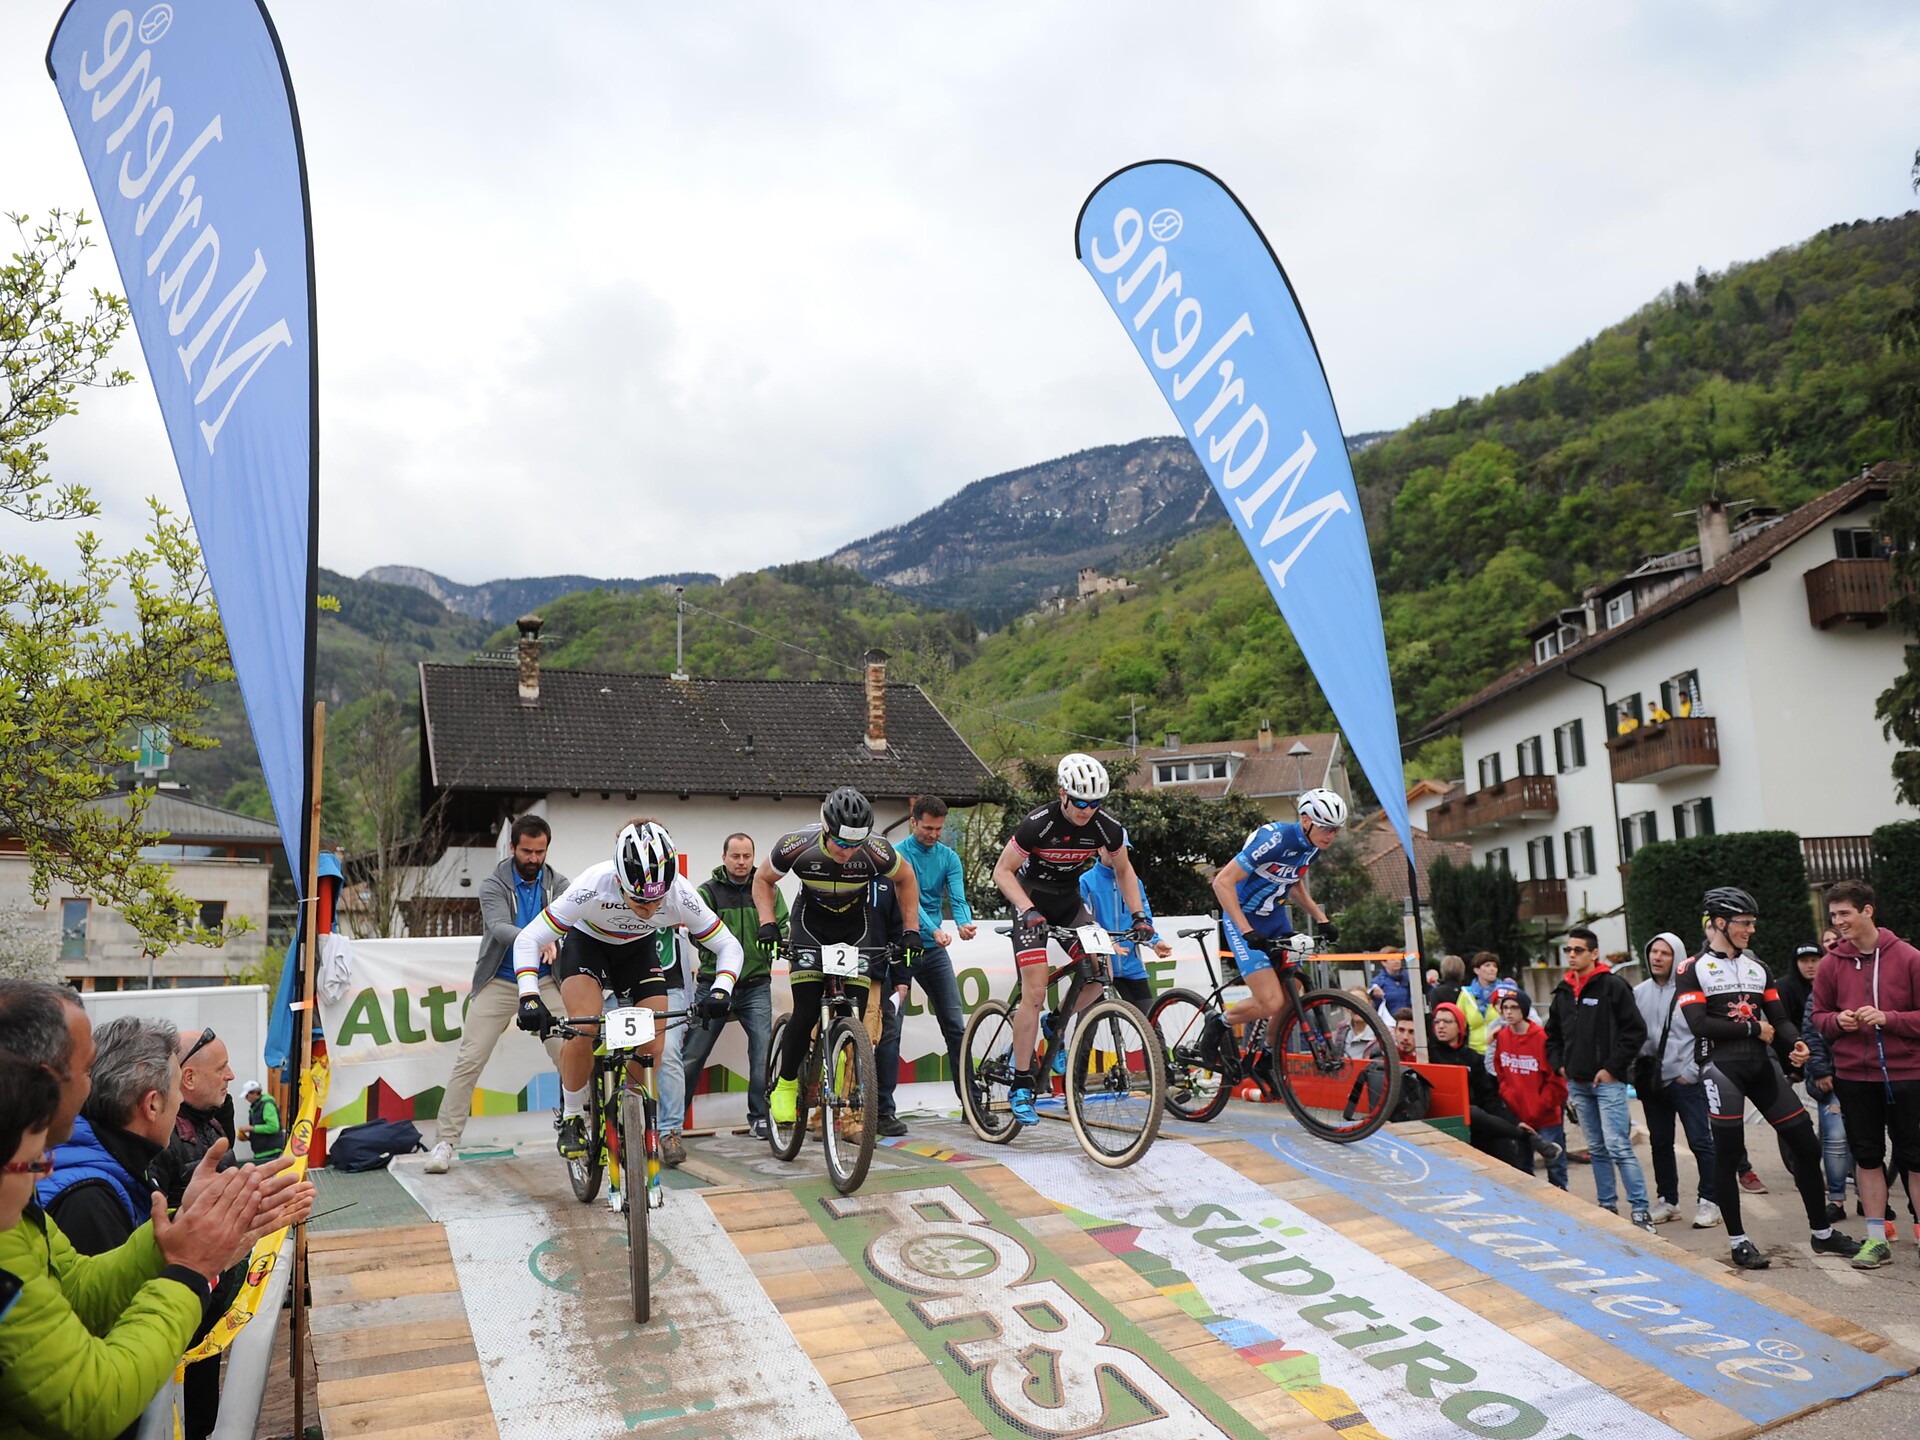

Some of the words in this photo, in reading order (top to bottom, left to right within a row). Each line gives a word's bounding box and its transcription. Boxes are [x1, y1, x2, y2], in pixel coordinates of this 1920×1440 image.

[780, 836, 808, 856] Herbaria
[867, 839, 890, 861] Herbaria
[1251, 837, 1278, 862] AGU
[1093, 931, 1101, 946] 1
[836, 950, 845, 966] 2
[624, 1017, 637, 1037] 5
[1704, 1078, 1721, 1115] KTM
[1384, 1189, 1813, 1388] Marlene
[818, 1183, 1240, 1440] FORS
